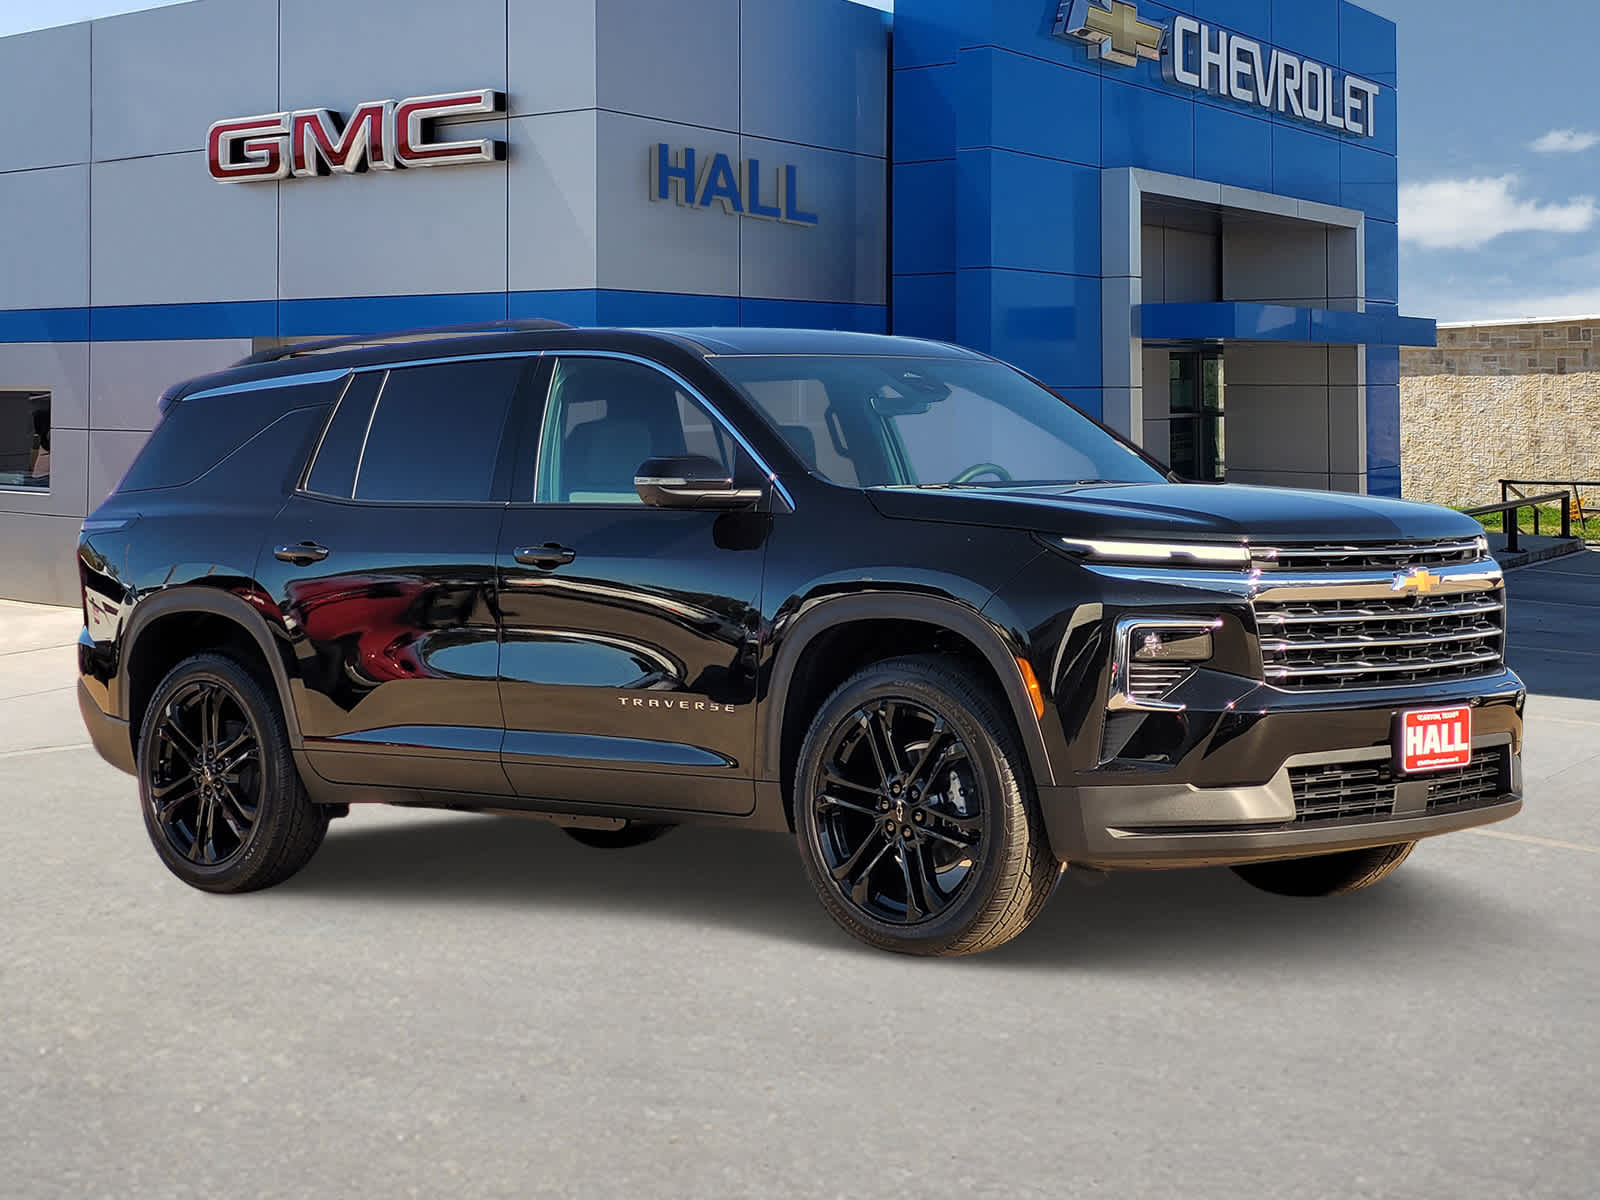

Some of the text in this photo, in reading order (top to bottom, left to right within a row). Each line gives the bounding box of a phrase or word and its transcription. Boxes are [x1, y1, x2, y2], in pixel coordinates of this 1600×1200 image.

[1174, 15, 1380, 137] CHEVROLET
[207, 88, 507, 184] GMC
[655, 142, 819, 227] HALL
[618, 697, 736, 713] TRAVERSE
[1407, 722, 1468, 756] HALL
